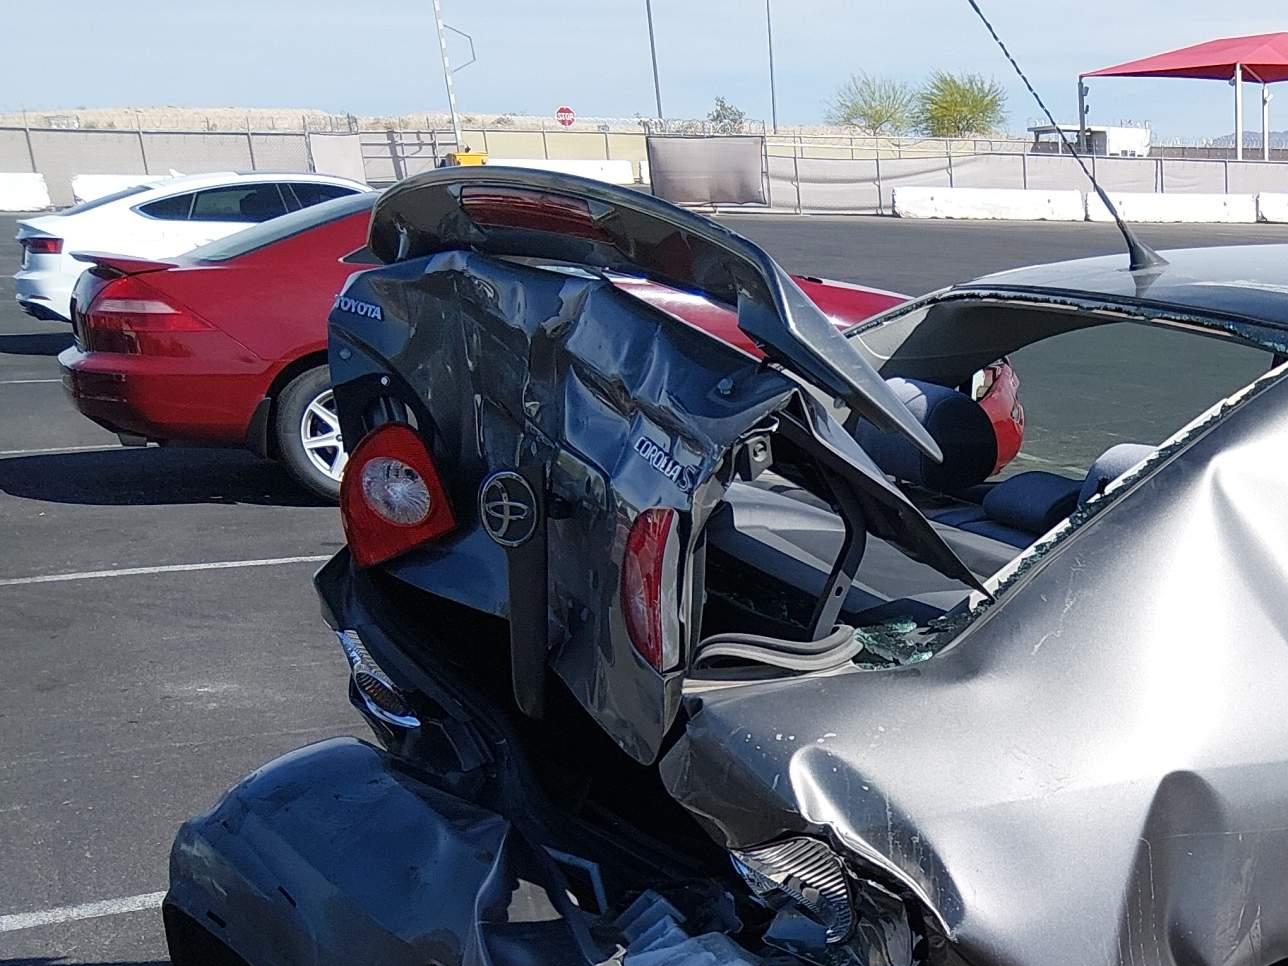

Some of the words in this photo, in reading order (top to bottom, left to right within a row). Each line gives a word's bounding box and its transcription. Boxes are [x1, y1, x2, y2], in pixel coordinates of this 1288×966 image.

[556, 112, 574, 121] STOP
[334, 295, 382, 321] TOYOTA
[633, 436, 682, 482] COROLLA
[678, 464, 697, 491] S
